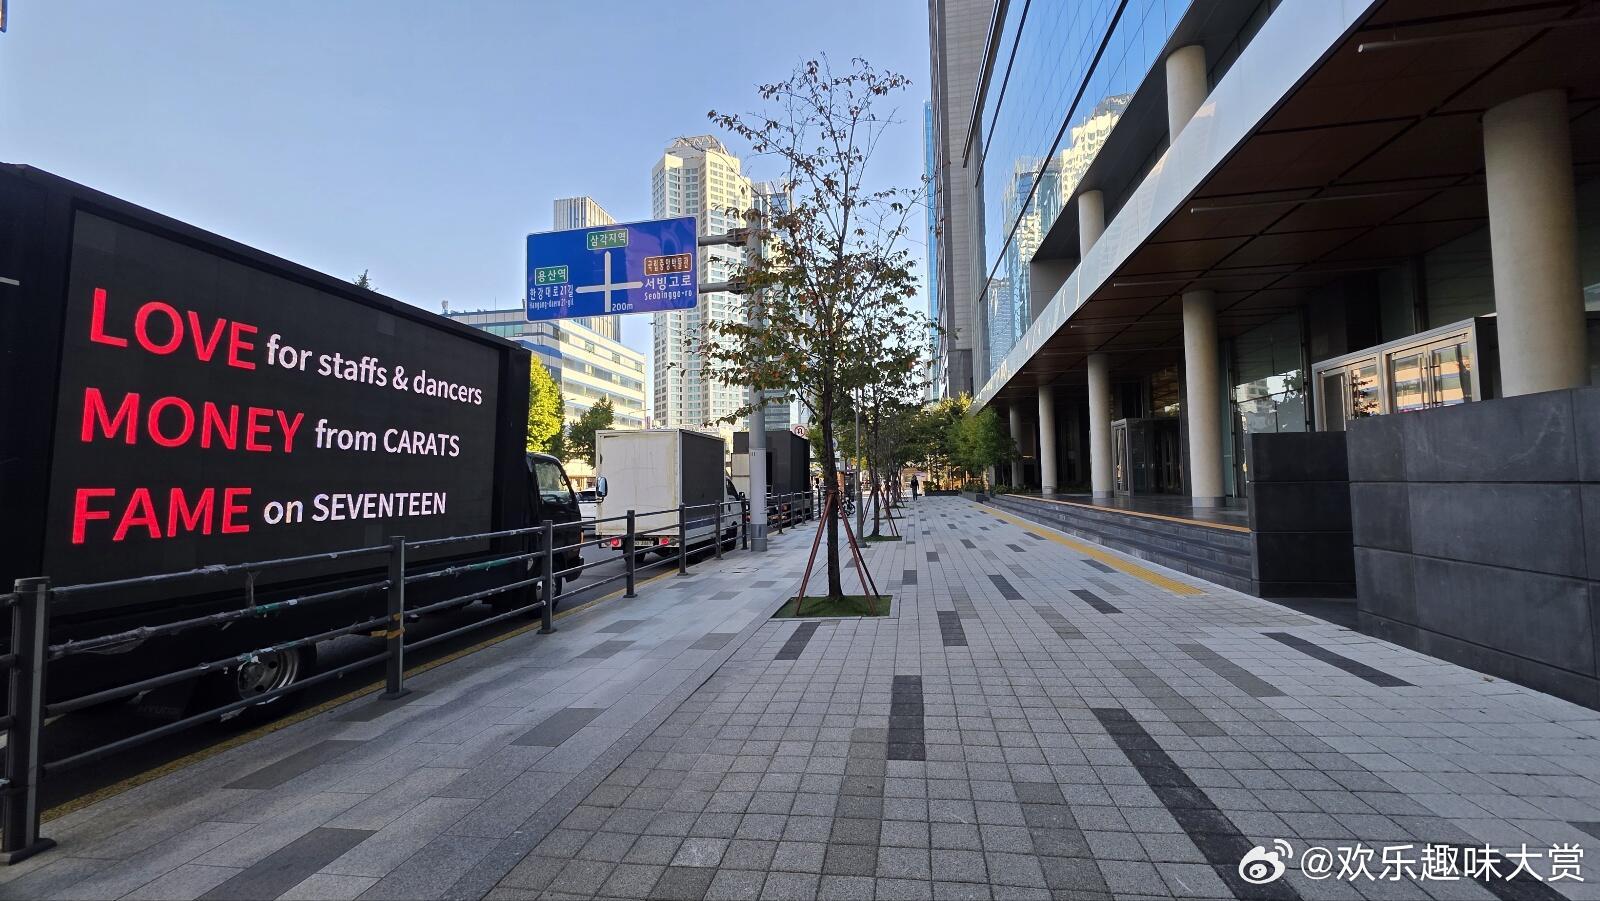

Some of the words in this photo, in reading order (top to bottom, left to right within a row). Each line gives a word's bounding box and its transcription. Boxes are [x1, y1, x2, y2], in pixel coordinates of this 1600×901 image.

[591, 231, 626, 247] 삼각지역
[538, 268, 566, 283] 용산역
[645, 275, 692, 291] 서빙고로
[529, 284, 574, 301] 한강대로21길
[644, 290, 693, 301] Seobinggo-ro
[612, 303, 634, 312] 200m
[90, 287, 258, 370] LOVE
[266, 334, 313, 372] for
[318, 352, 388, 387] staffs
[393, 365, 409, 392] &
[413, 369, 483, 406] dancers
[81, 387, 305, 453] MONEY
[315, 418, 377, 452] from
[383, 428, 460, 457] CARATS
[72, 487, 252, 545] FAME
[263, 500, 304, 525] on
[311, 492, 447, 522] SEVENTEEN
